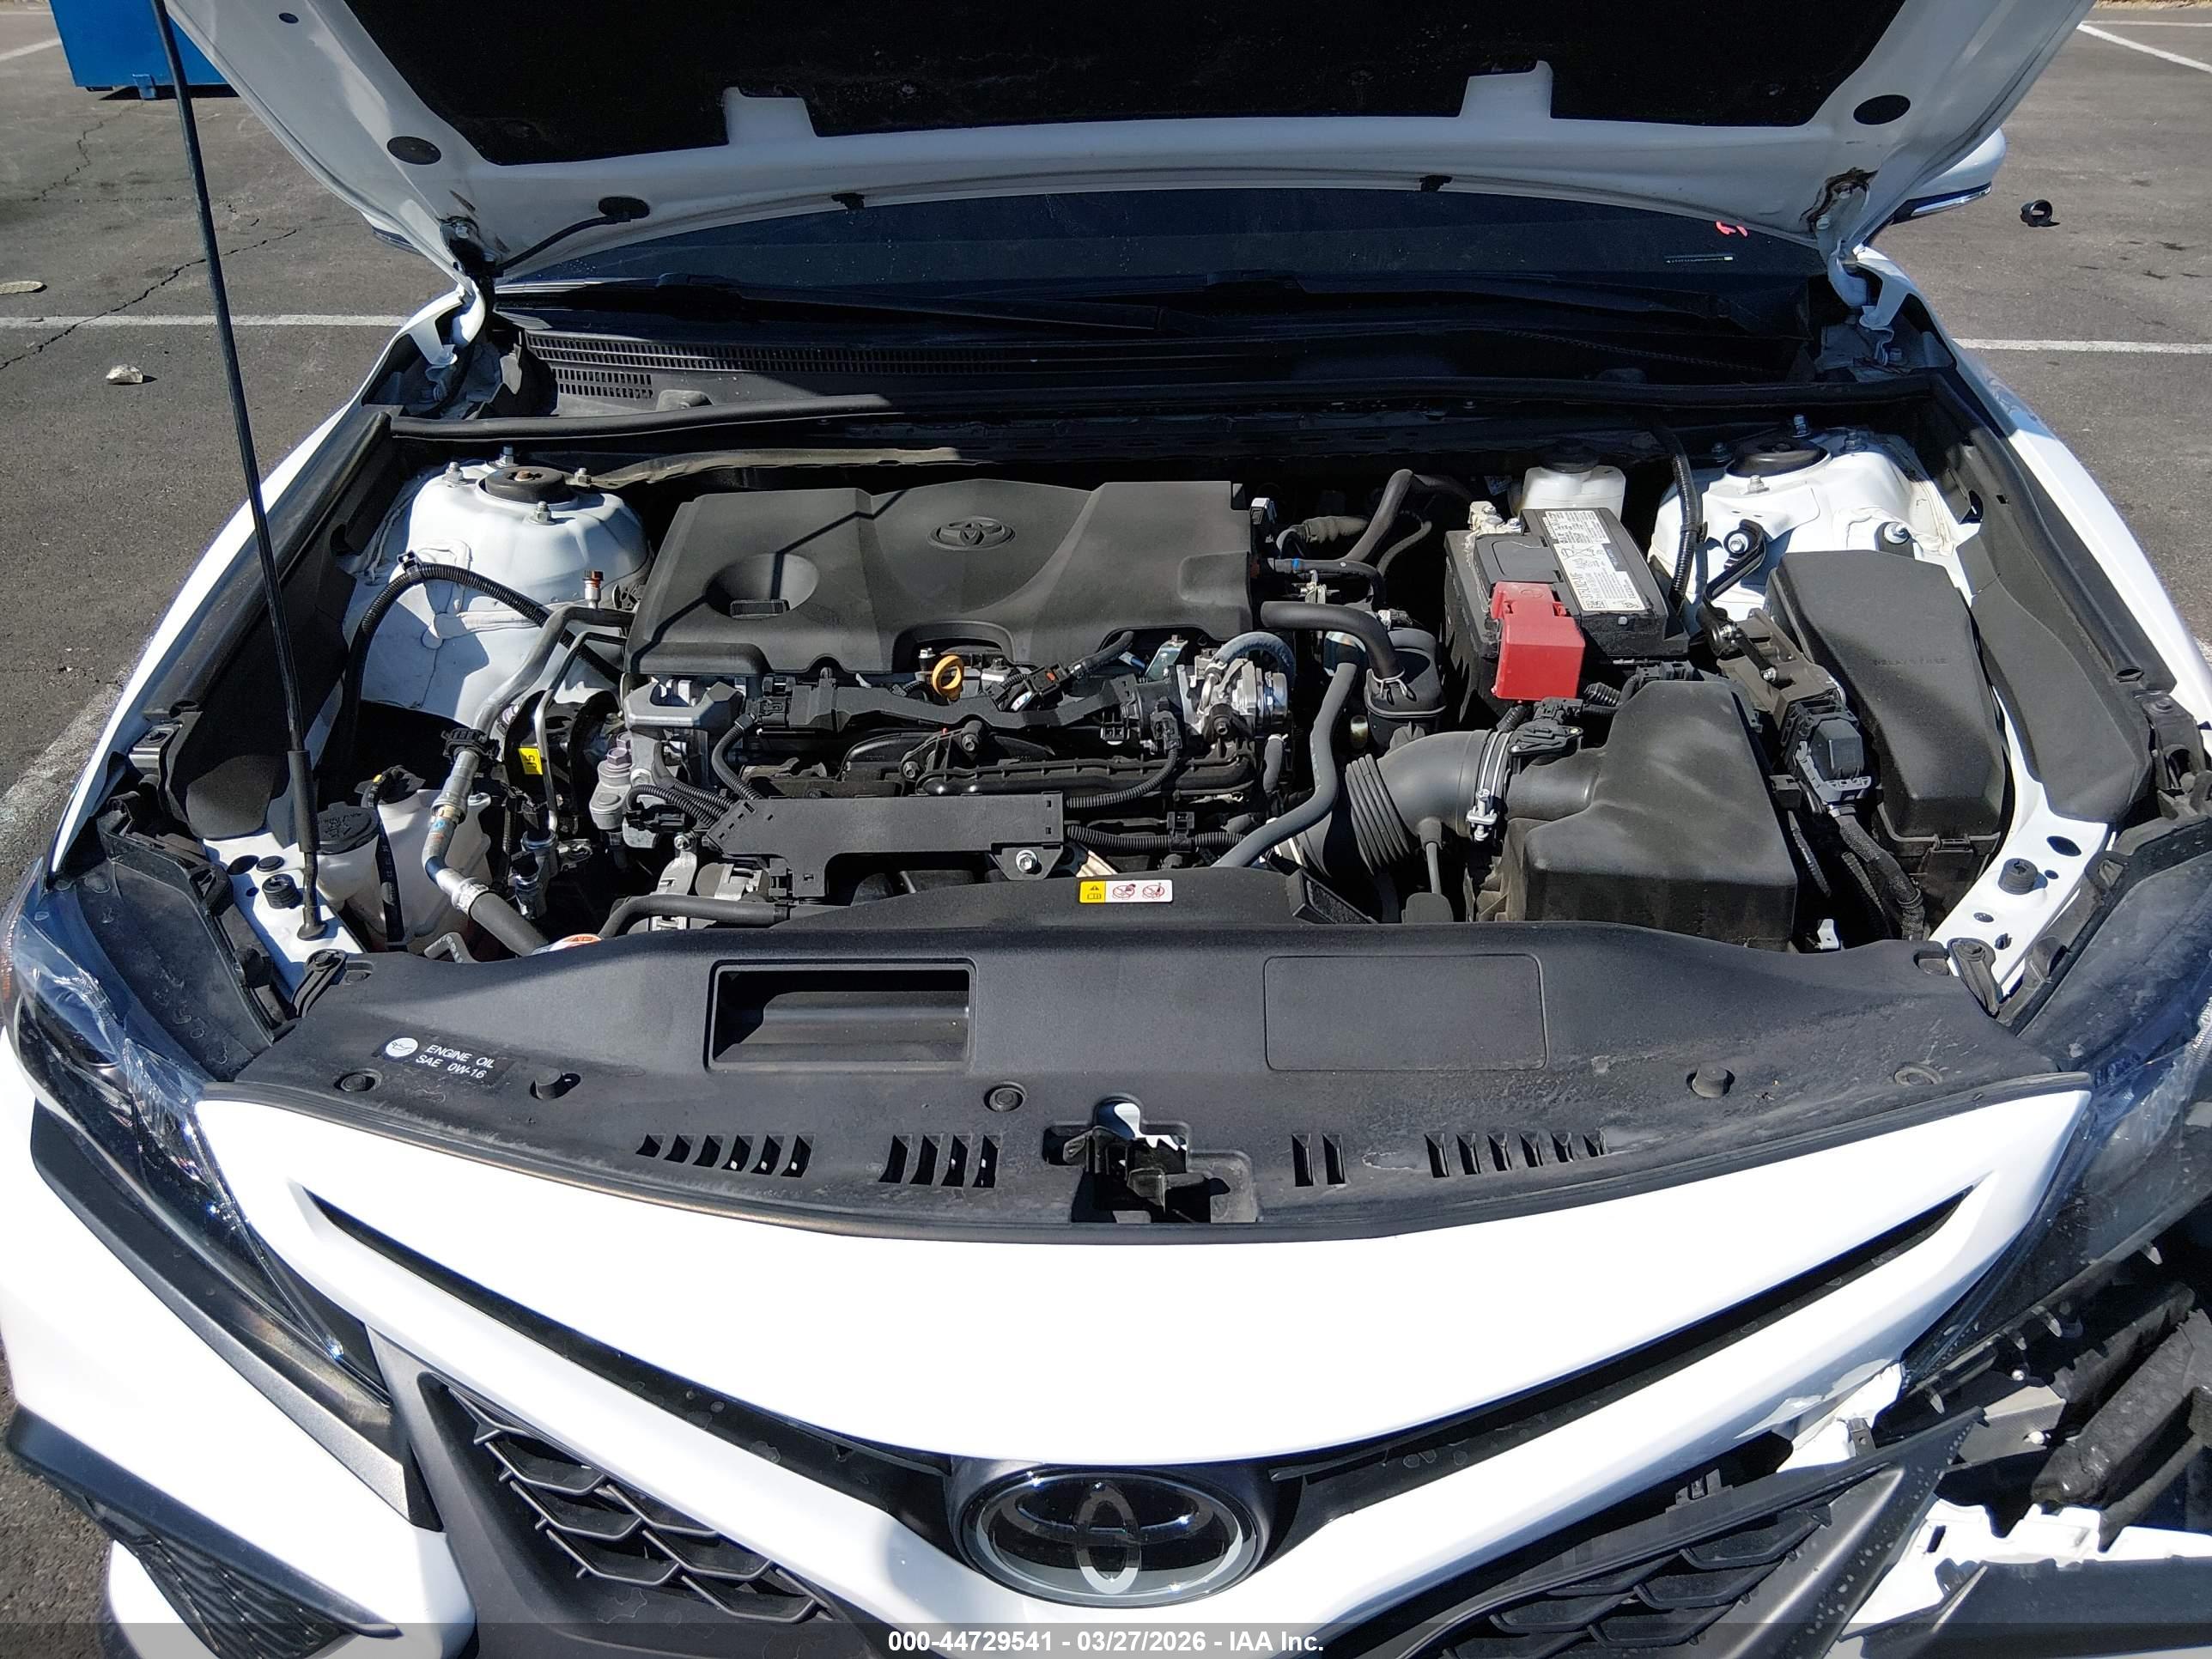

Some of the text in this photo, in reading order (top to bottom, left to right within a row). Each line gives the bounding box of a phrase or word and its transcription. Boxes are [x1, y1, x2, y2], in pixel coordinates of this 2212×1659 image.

[416, 1054, 444, 1067] SAE
[426, 1044, 495, 1069] ENGINE OIL
